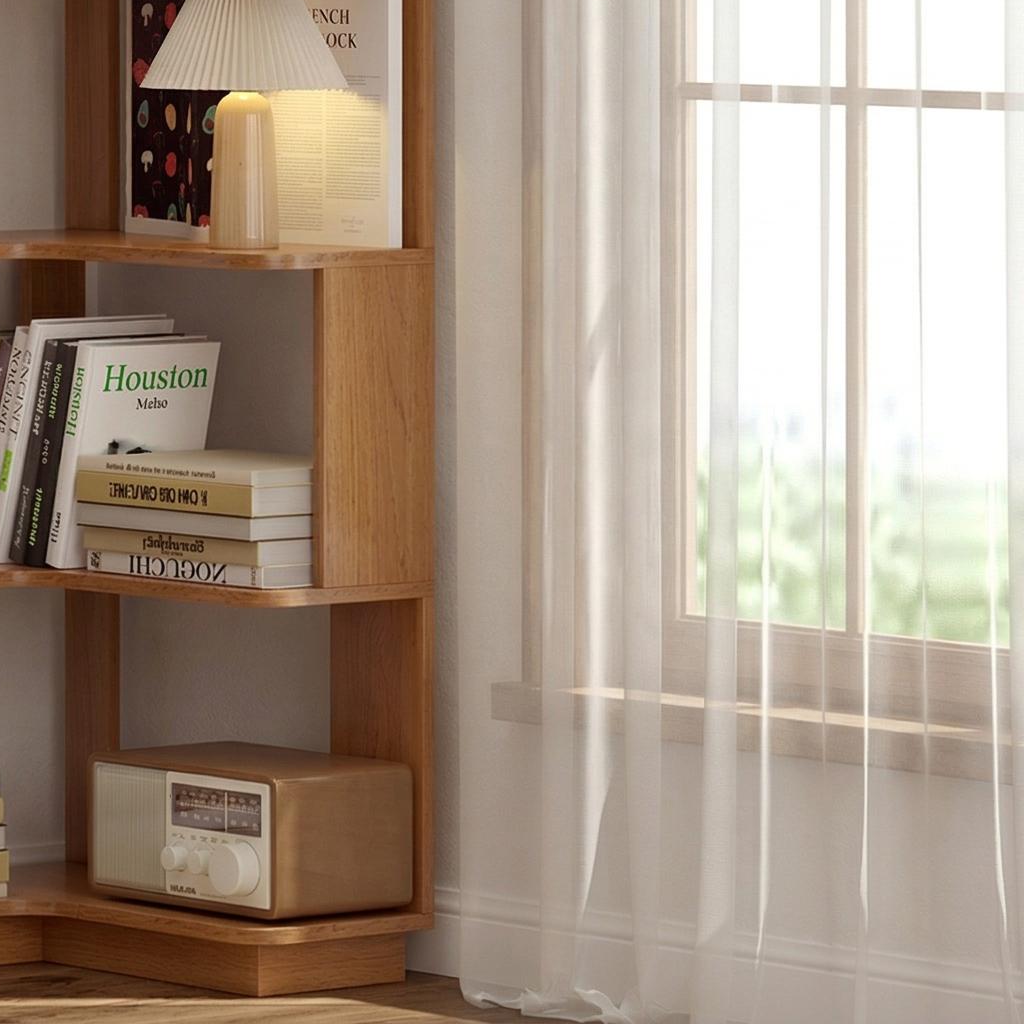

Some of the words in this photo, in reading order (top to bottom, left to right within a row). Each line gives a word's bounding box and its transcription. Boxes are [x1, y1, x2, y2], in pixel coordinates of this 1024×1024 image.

[307, 8, 350, 25] ENCH
[322, 32, 358, 49] OCK
[103, 364, 208, 393] Houston
